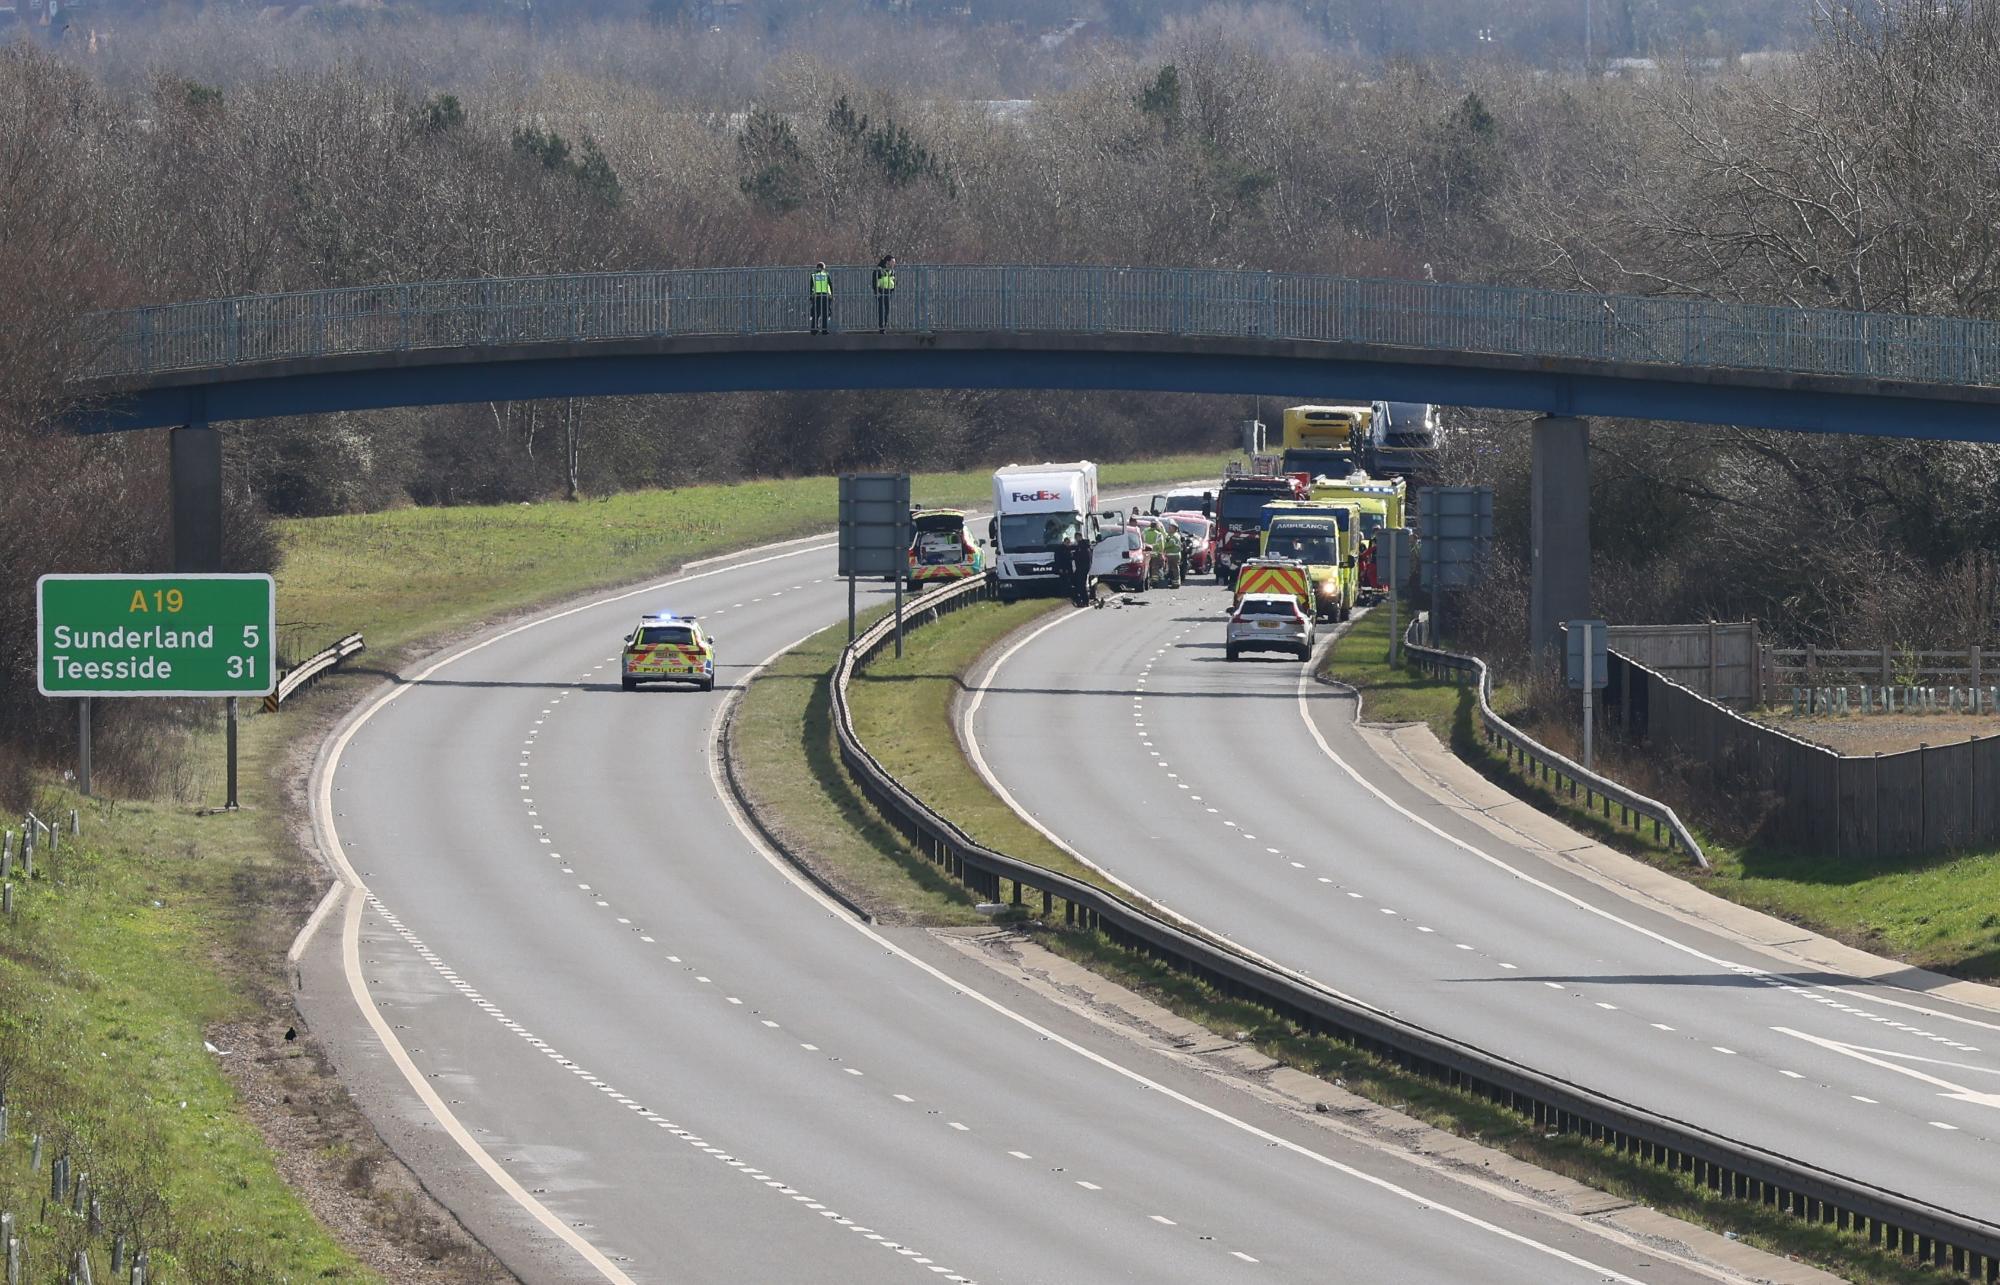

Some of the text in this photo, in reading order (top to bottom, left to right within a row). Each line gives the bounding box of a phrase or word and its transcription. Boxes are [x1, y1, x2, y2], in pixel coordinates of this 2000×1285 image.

[1012, 490, 1060, 502] FedEx
[129, 589, 183, 612] A19
[54, 625, 259, 649] Sunderland 5
[53, 656, 256, 679] Teesside 31
